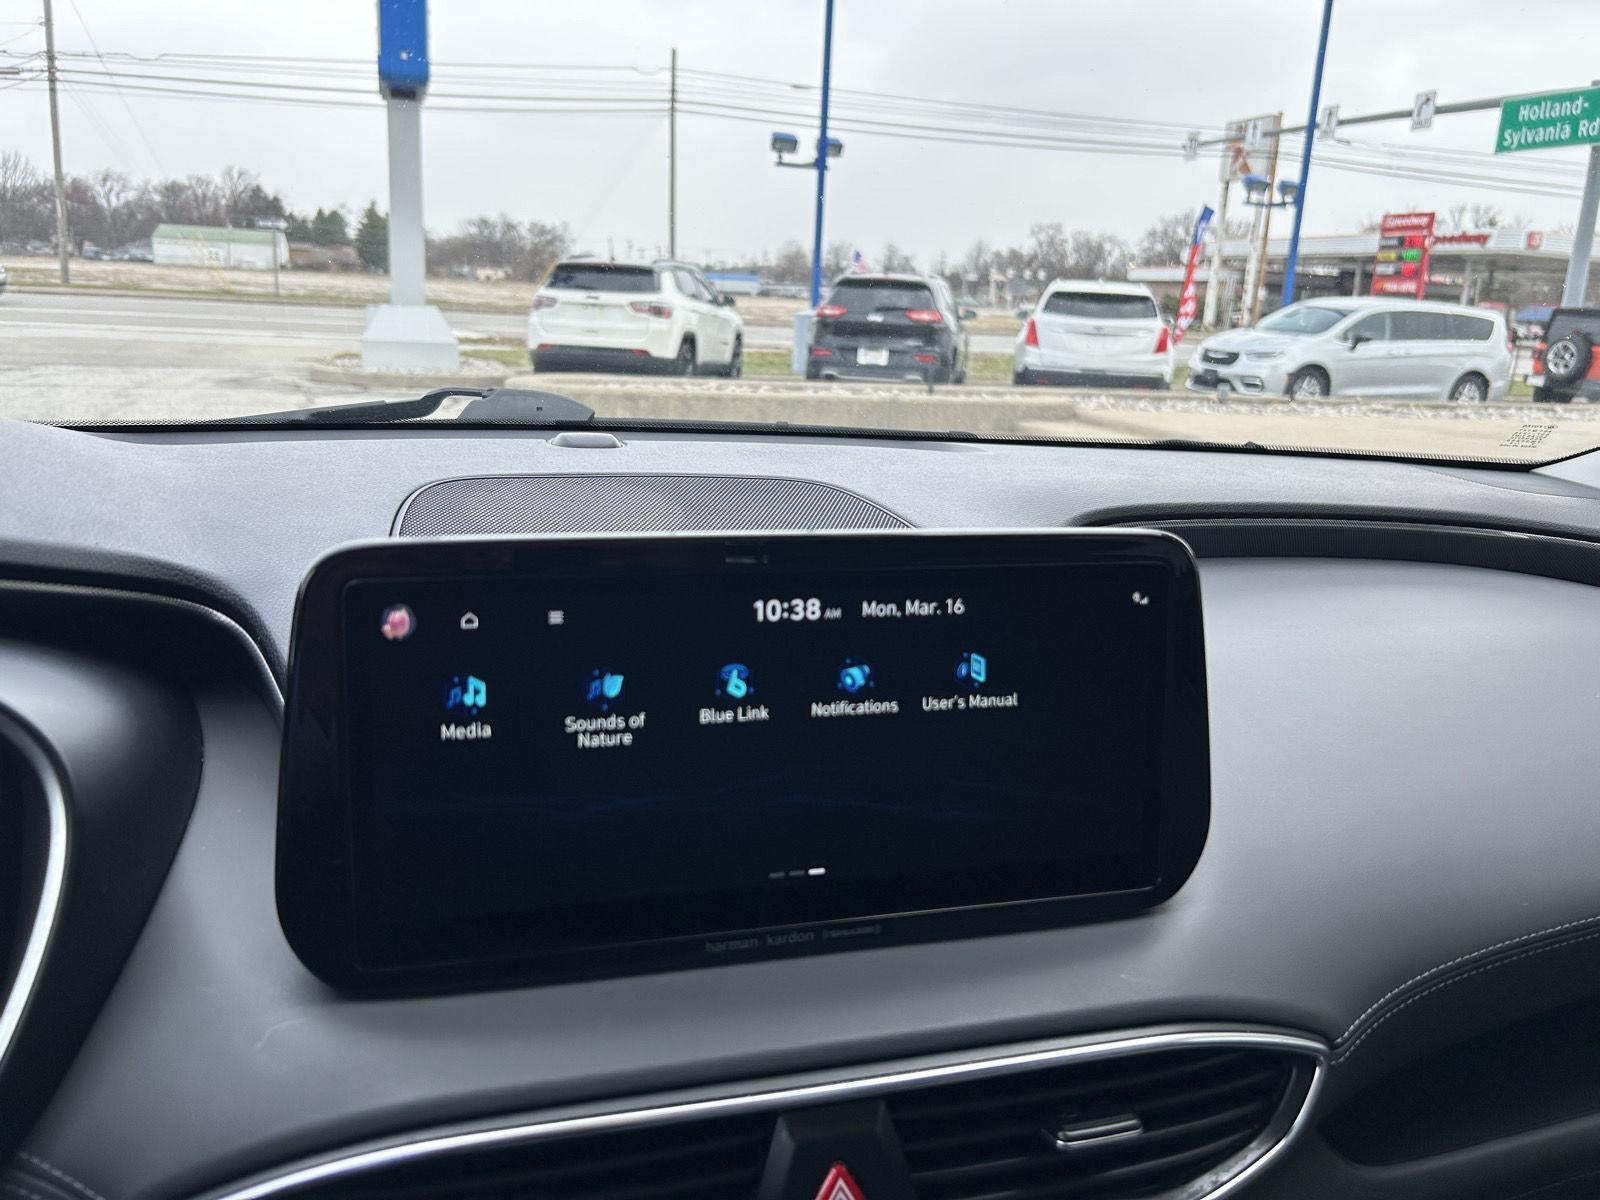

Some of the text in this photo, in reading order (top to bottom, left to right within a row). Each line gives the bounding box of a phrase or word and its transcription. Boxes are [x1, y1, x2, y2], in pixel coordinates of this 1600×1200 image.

[1518, 95, 1589, 121] Holland-
[1503, 117, 1600, 149] Sylvania Rd
[753, 597, 842, 622] 10:38 AM
[905, 599, 941, 616] Mar.
[945, 598, 965, 615] 16
[810, 699, 900, 718] Notifications
[922, 692, 1018, 712] User's Manual
[564, 711, 646, 733] Sounds of
[699, 705, 770, 725] Blue Link
[440, 722, 492, 740] Media
[577, 731, 633, 749] Nature
